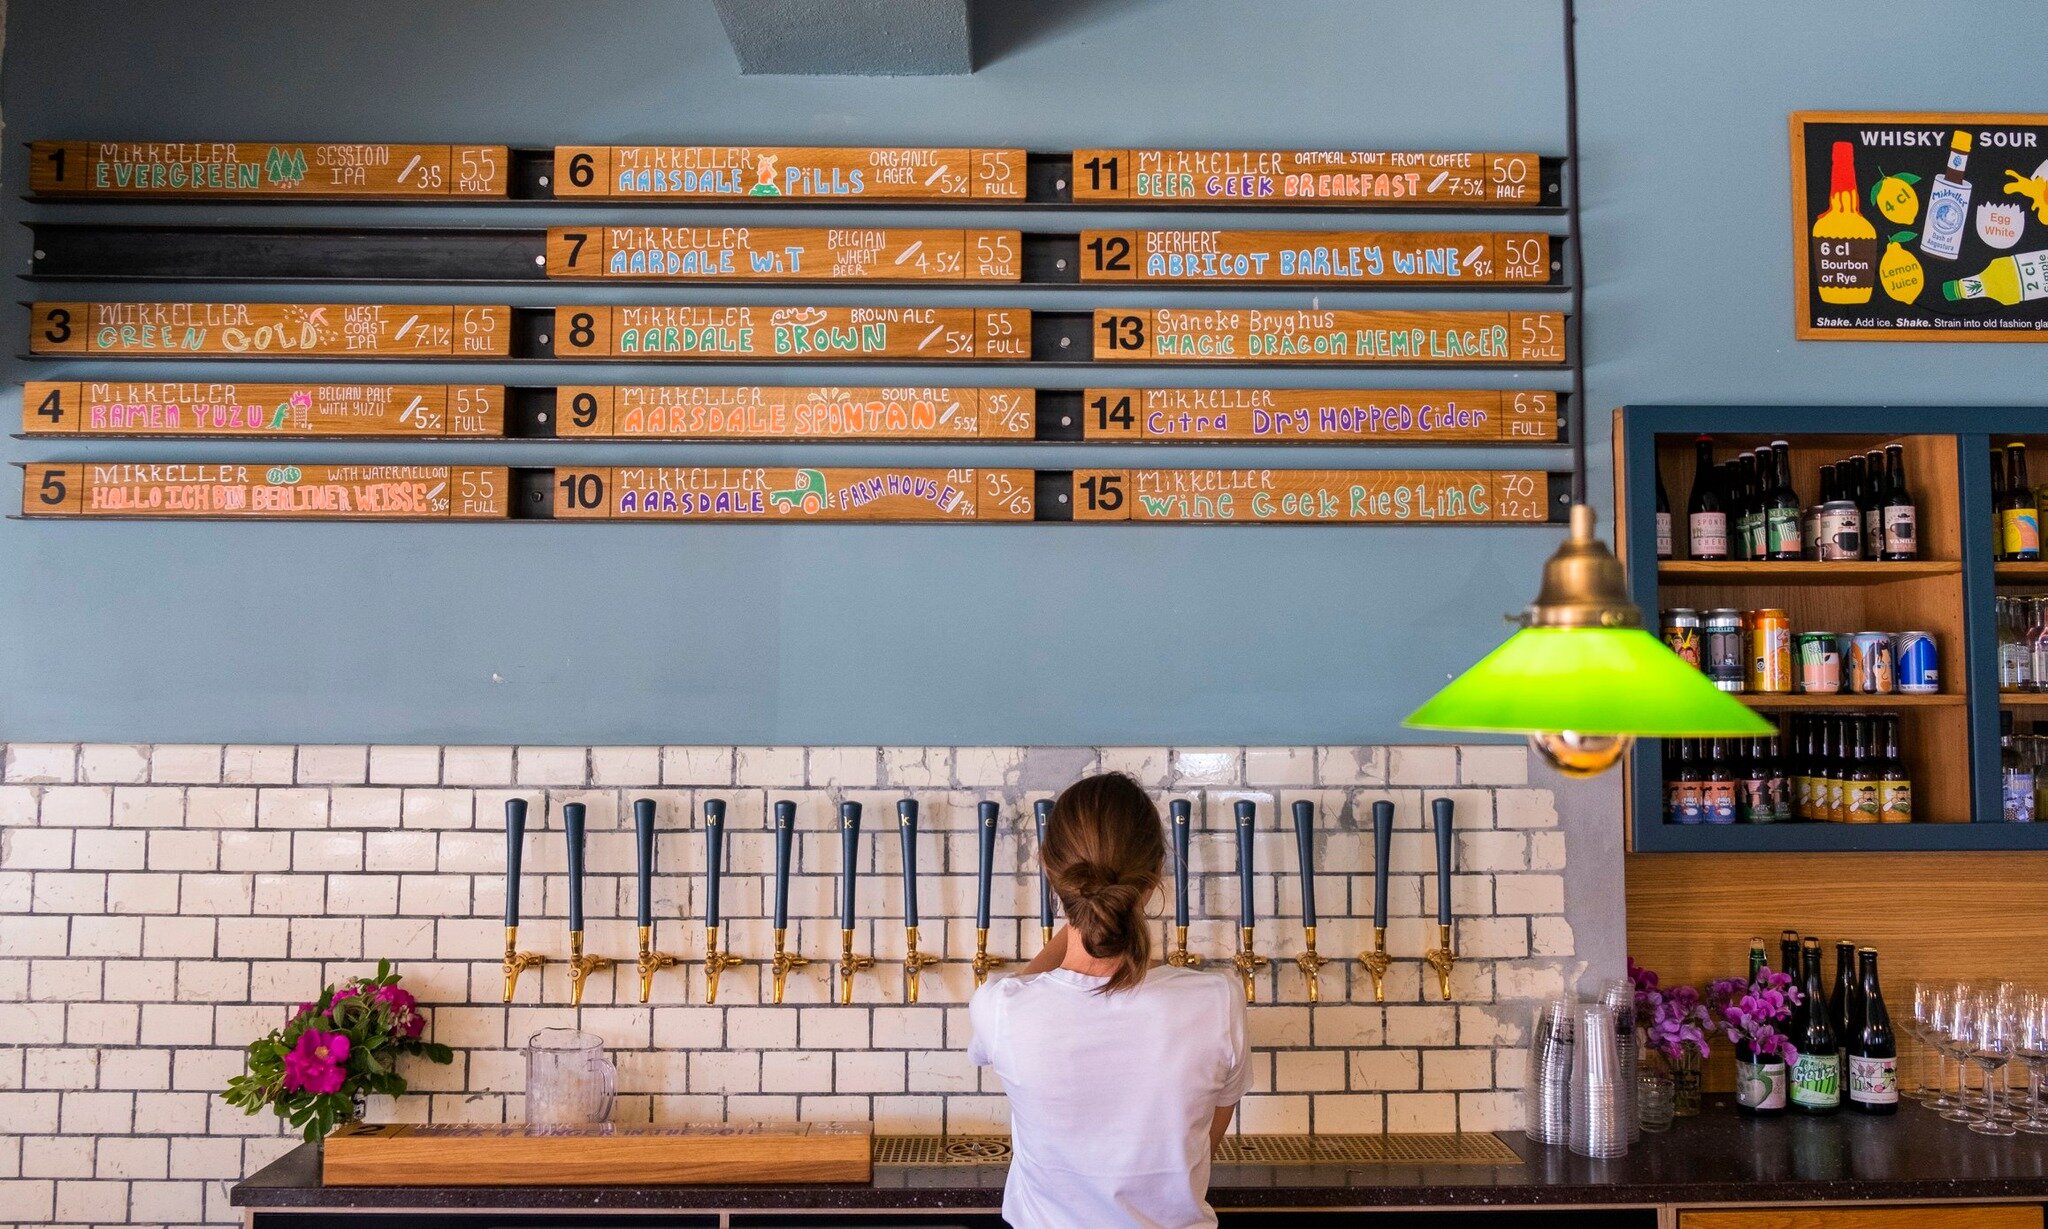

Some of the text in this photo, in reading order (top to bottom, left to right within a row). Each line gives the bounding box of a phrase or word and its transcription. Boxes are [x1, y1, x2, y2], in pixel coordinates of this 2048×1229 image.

[1860, 131, 2037, 147] WHISKY SOUR
[48, 149, 64, 181] 1
[316, 146, 389, 166] SESSION
[461, 149, 495, 181] 55
[870, 150, 938, 167] ORGANIC
[980, 152, 1010, 180] 55
[1295, 151, 1472, 168] OATMEAL STOUT FROM COFFEE
[96, 163, 260, 189] EVERGREEN
[330, 168, 365, 185] IPA
[569, 154, 594, 187] 6
[619, 169, 743, 193] AARSDALE
[876, 168, 917, 184] LAGER
[1084, 157, 1117, 190] 11
[1493, 158, 1526, 183] 50
[460, 180, 492, 191] FULL
[940, 175, 968, 194] 5%
[986, 182, 1017, 195] FULL
[1138, 172, 1420, 200] BEER GEEK BREAKFAST
[1449, 178, 1484, 196] 7.5%
[1497, 185, 1525, 199] HALF
[1885, 188, 1911, 213] 4 cl
[1932, 189, 1968, 207] Mikkeller
[1990, 213, 2011, 225] Egg
[828, 229, 886, 250] BELGIAN
[1932, 233, 1945, 242] Dash
[1985, 226, 2015, 237] White
[564, 234, 587, 267] 7
[977, 236, 1013, 263] 55
[1147, 231, 1221, 254] BEERHERE
[1506, 239, 1540, 265] 50
[1820, 242, 1849, 256] 6 cl
[1927, 239, 1954, 251] Angostura
[610, 250, 735, 274] AARDALE
[837, 249, 878, 265] WHEAT
[915, 251, 961, 274] 4.5%
[1087, 237, 1130, 271] 12
[1147, 252, 1269, 277] ABRICOT
[1280, 247, 1384, 276] BARLEY
[833, 264, 868, 277] BEER
[980, 265, 1014, 276] FULL
[1474, 260, 1493, 277] 8%
[1505, 266, 1542, 278] HALF
[1821, 260, 1868, 270] Bourbon
[1881, 262, 1919, 279] Lemon
[1837, 273, 1857, 284] Rye
[1890, 276, 1918, 291] Juice
[2027, 282, 2039, 291] 2
[344, 306, 382, 322] WEST
[464, 308, 495, 334] 65
[851, 309, 935, 323] BROWN ALE
[987, 313, 1011, 336] 55
[1157, 309, 1335, 336] Svaneke Bryghus
[1816, 317, 2032, 328] Shake. Add ice. Shake. Strain into old fashion
[45, 309, 71, 343] 3
[97, 317, 318, 352] GREEN GOLD
[344, 321, 389, 335] COAST
[415, 324, 450, 348] 7.1%
[569, 313, 595, 348] 8
[1101, 316, 1144, 350] 13
[1522, 315, 1552, 344] 55
[345, 335, 377, 349] IPA
[464, 337, 494, 351] FULL
[621, 323, 887, 355] AARDALE BROWN
[946, 331, 973, 354] 5%
[987, 338, 1025, 353] FULL
[1356, 328, 1425, 357] HEMP
[1431, 325, 1508, 357] LAGER
[1522, 347, 1560, 358] FULL
[319, 386, 393, 403] BELGIAN PALE
[457, 388, 489, 414] 55
[882, 388, 949, 402] SOUR ALE
[1515, 392, 1547, 413] 65
[37, 390, 64, 423] 4
[91, 404, 263, 429] RAMEN YUZU
[319, 402, 347, 416] WITH
[572, 393, 597, 427] 9
[1091, 397, 1134, 429] 14
[414, 407, 440, 429] 5%
[455, 416, 486, 432] FULL
[624, 404, 936, 435] AARSDALE SPONTAN
[1147, 410, 1227, 433] Citra
[1253, 408, 1310, 434] Dry
[1418, 402, 1487, 432] Cider
[1512, 422, 1546, 436] FULL
[94, 465, 249, 484] MIKKELLER
[362, 466, 448, 481] WATERMELLON
[947, 469, 974, 483] ALE
[40, 470, 66, 505] 5
[462, 471, 493, 498] 55
[560, 474, 603, 509] 10
[620, 474, 956, 515] AARSDALE FARMHOUSE
[1080, 476, 1123, 511] 15
[1502, 475, 1534, 498] 70
[92, 481, 427, 513] HALLO ICH BIN BERLINER WEISSE
[464, 500, 498, 514] FULL
[1252, 489, 1339, 517] Geek
[706, 815, 717, 826] M
[844, 816, 854, 829] k
[901, 814, 911, 826] k
[1176, 815, 1186, 825] e
